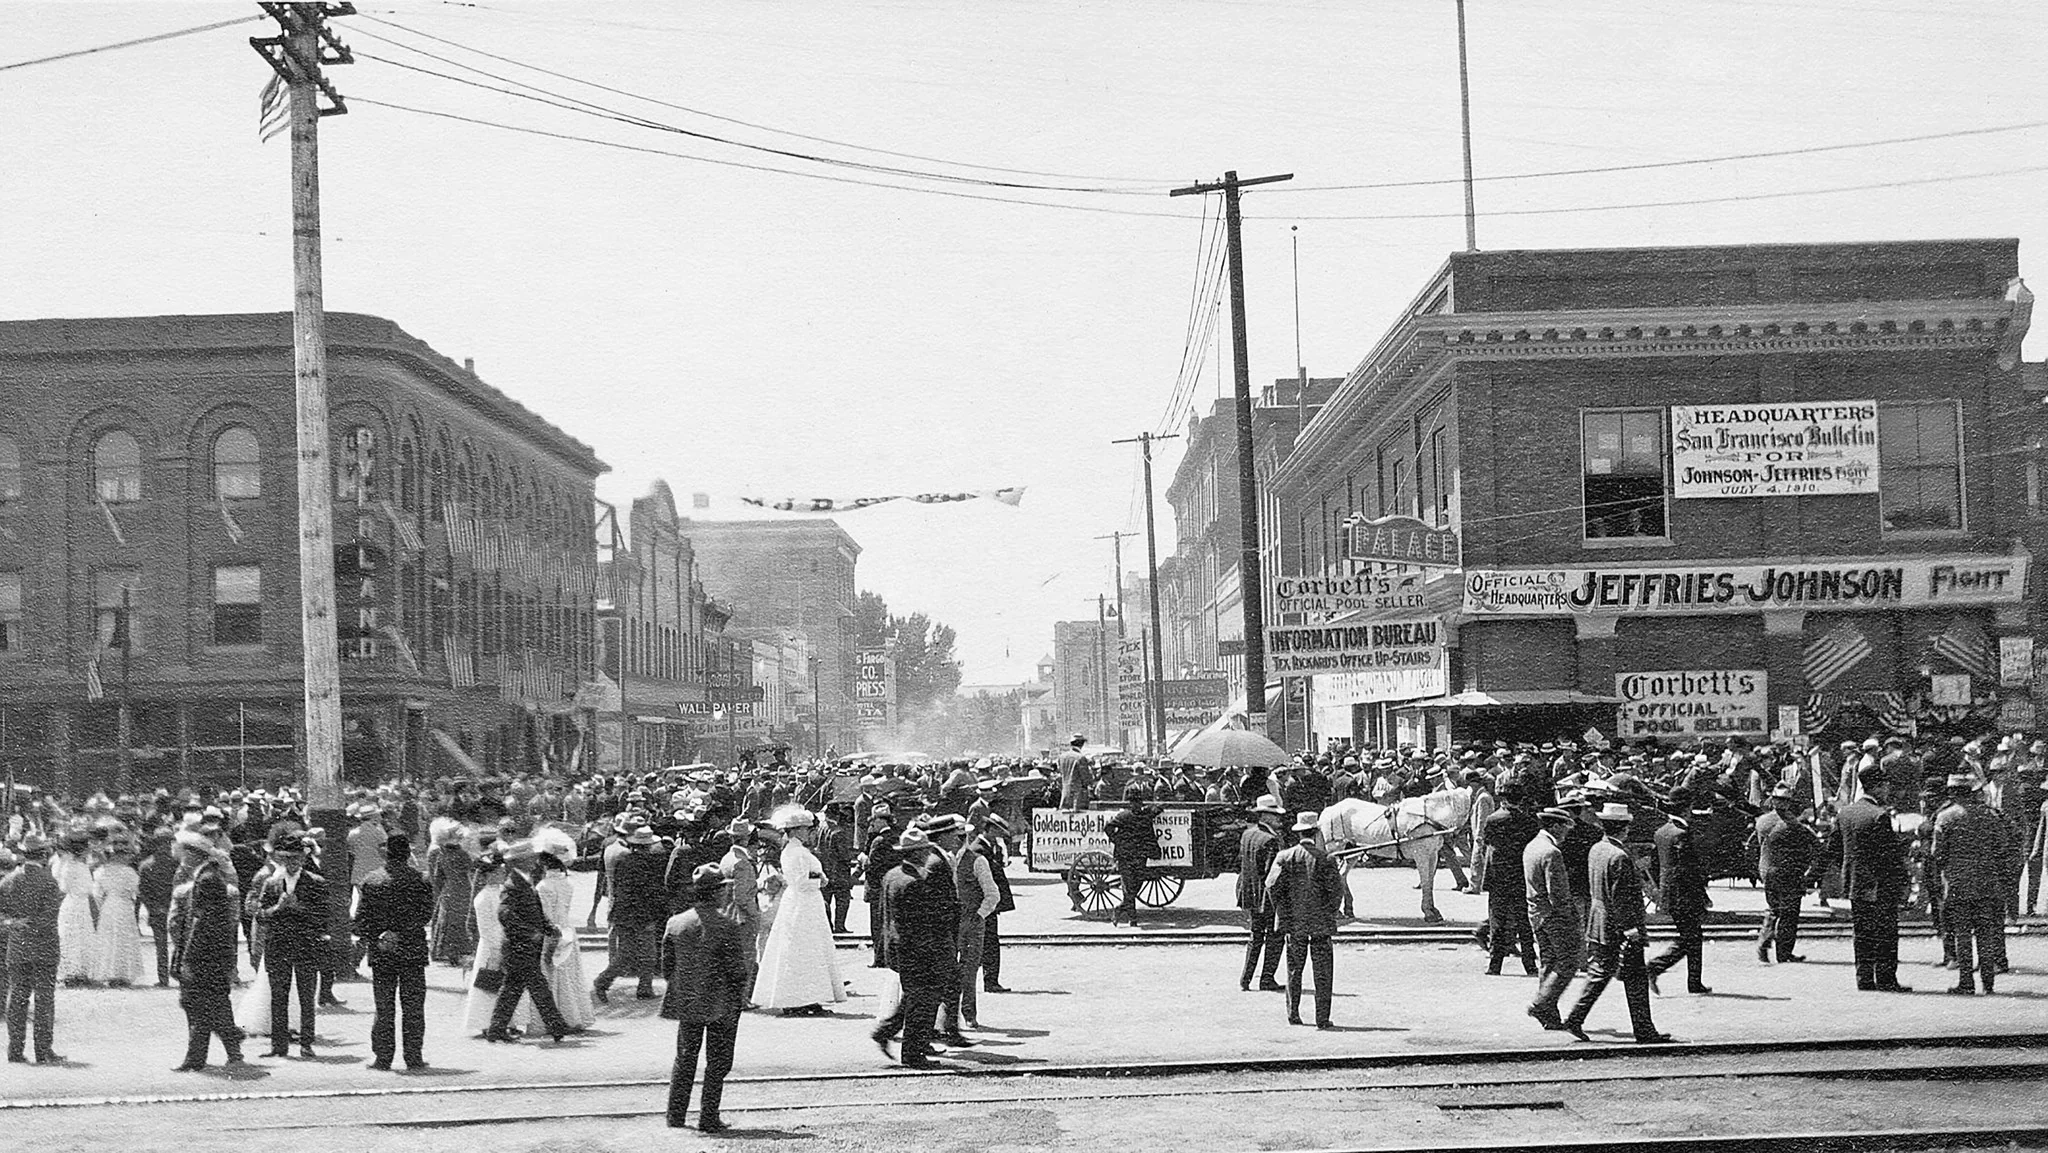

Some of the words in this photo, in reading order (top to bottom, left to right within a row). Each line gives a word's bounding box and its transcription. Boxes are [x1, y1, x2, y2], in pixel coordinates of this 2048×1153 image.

[1694, 405, 1875, 425] HEADQUARTERS
[1675, 426, 1713, 455] San
[1715, 426, 1804, 454] Francisco
[1804, 424, 1876, 451] Bulletin
[1745, 451, 1804, 462] FOR
[1682, 464, 1833, 486] JOHNSON-JEFFRIES
[1721, 485, 1758, 495] JULY
[1355, 526, 1456, 562] PALACE
[1276, 575, 1391, 598] Corbett's
[1471, 573, 1546, 593] OFFICIAL
[1570, 568, 1904, 606] JEFFRIES-JOHNSON
[1930, 564, 2011, 598] FIGHT
[1279, 597, 1331, 611] OFFICIAL
[1336, 598, 1370, 609] POOL
[1490, 589, 1568, 609] HEADQUARTERS
[1270, 625, 1369, 654] INFORMATION
[1371, 621, 1437, 647] BUREAU
[1272, 655, 1290, 673] TEX
[1291, 653, 1339, 671] RICKARD'S
[1340, 652, 1373, 667] OFFICE
[1375, 650, 1431, 667] UP-STAIRS
[856, 681, 885, 697] PRESS
[1621, 671, 1755, 701] Corbett's
[679, 702, 710, 714] WALL
[1637, 702, 1718, 718] OFFICIAL
[1166, 712, 1200, 725] ohnson
[1633, 718, 1685, 734] POOL
[1693, 716, 1763, 732] SELLER
[1033, 813, 1067, 833] Golden
[1069, 814, 1095, 838] Eagle
